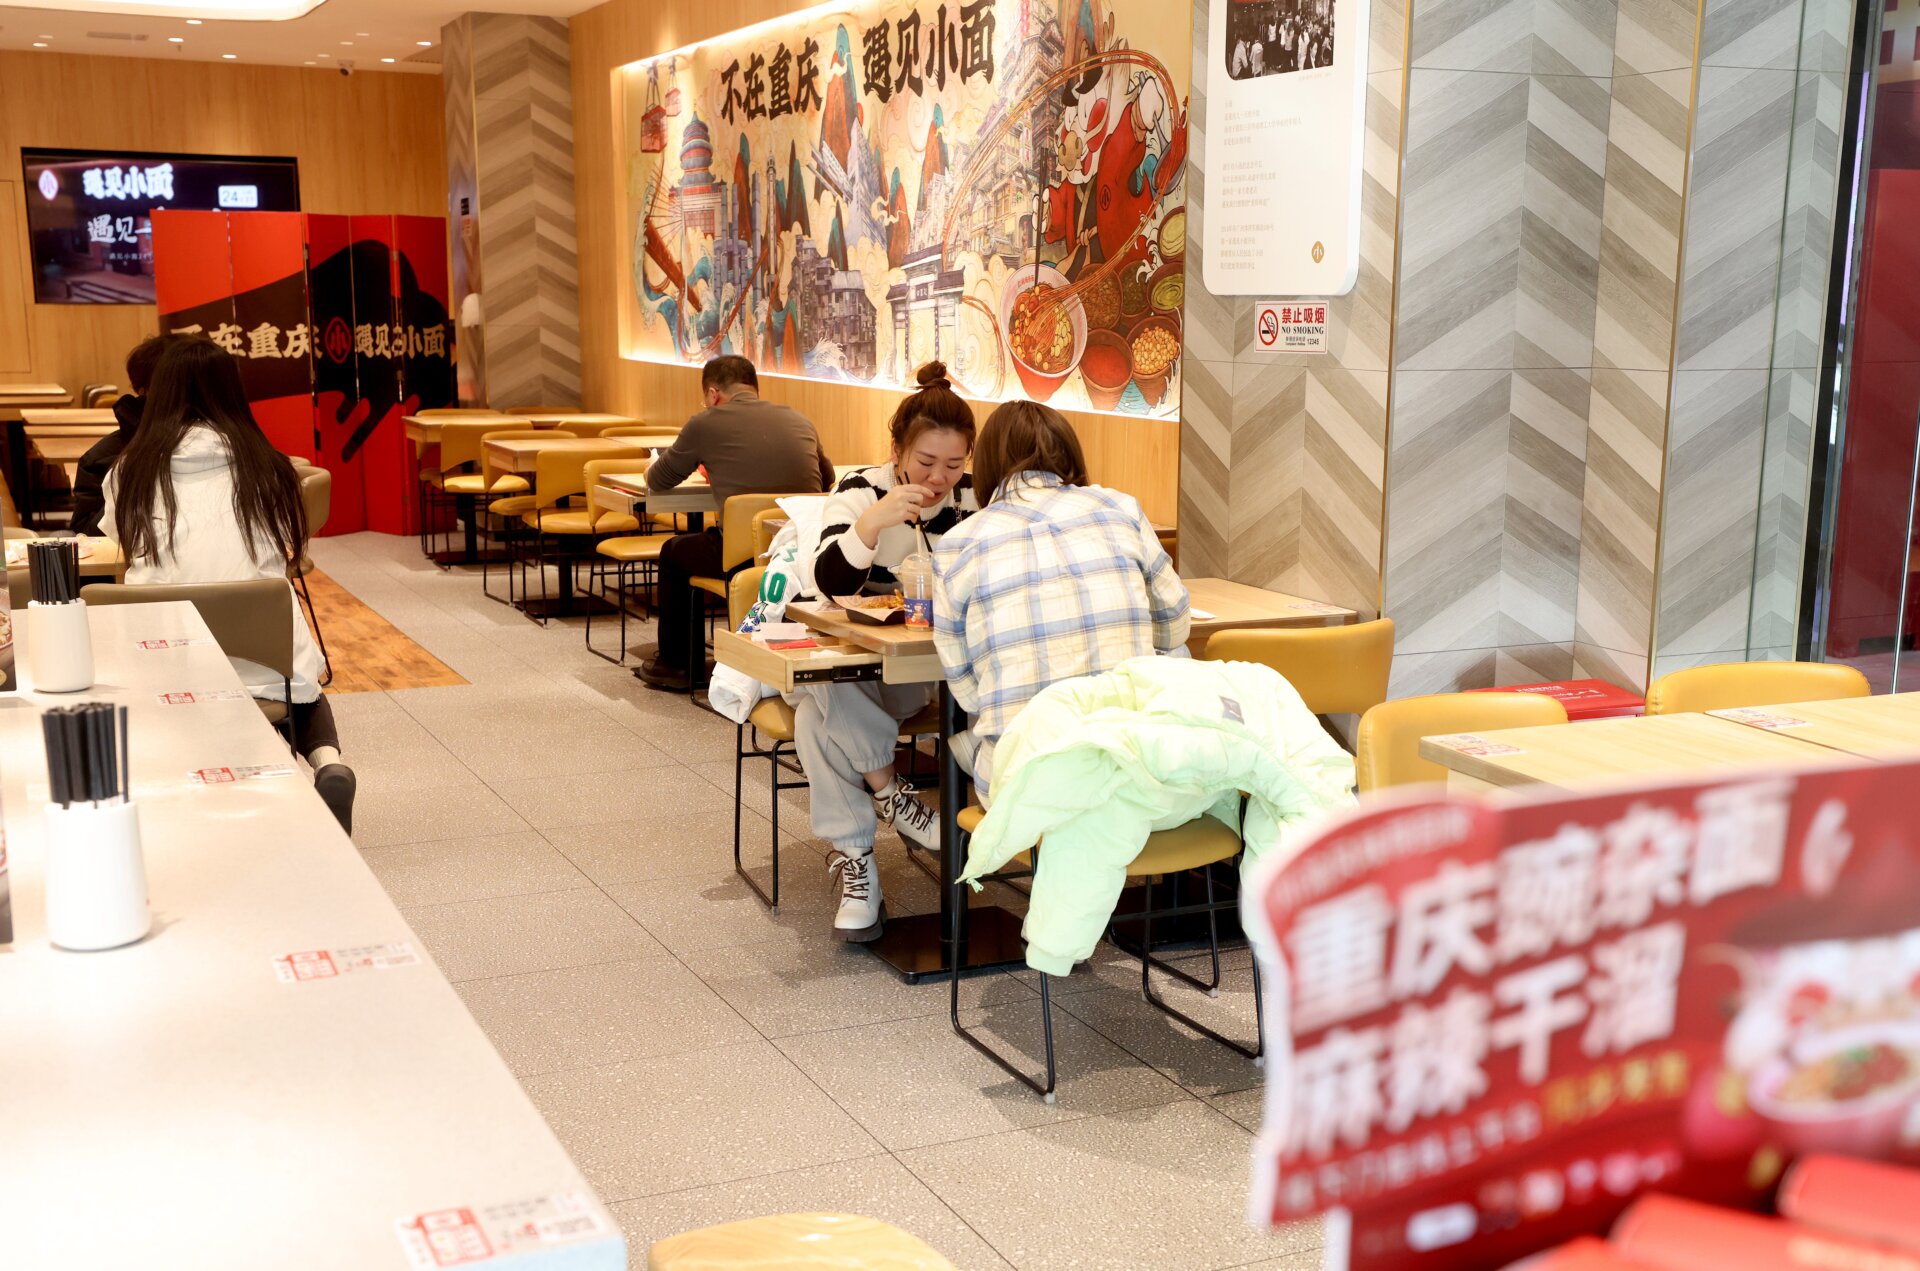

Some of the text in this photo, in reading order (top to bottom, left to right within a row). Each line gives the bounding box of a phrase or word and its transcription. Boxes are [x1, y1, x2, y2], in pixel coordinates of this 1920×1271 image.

[721, 0, 996, 125] 不在重庆 遇见小面
[84, 163, 173, 200] 遇见小面
[1282, 307, 1325, 324] 禁止吸烟
[1282, 326, 1324, 334] NO SMOKING
[355, 323, 446, 359] 遇见小面
[1289, 776, 1794, 1036] 重庆豌杂面
[1286, 926, 1686, 1156] 麻辣干溜
